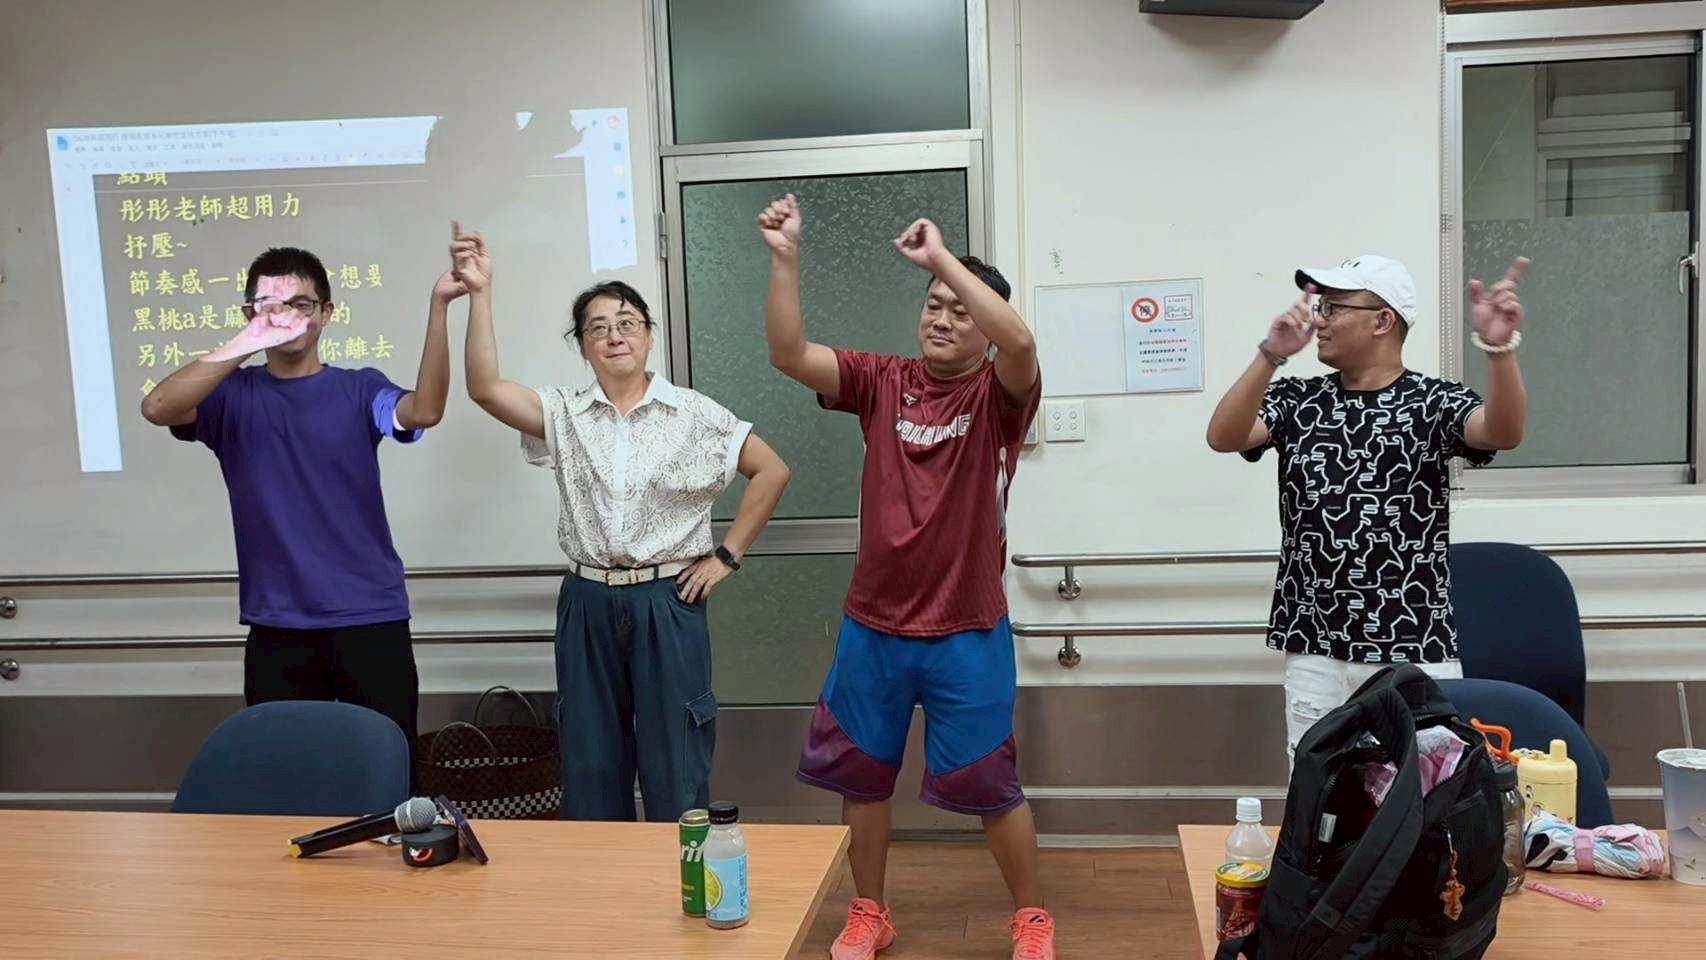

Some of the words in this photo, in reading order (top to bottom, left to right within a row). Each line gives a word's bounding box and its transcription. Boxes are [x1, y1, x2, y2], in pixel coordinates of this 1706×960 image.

[120, 192, 300, 222] 彤彤老師超用力
